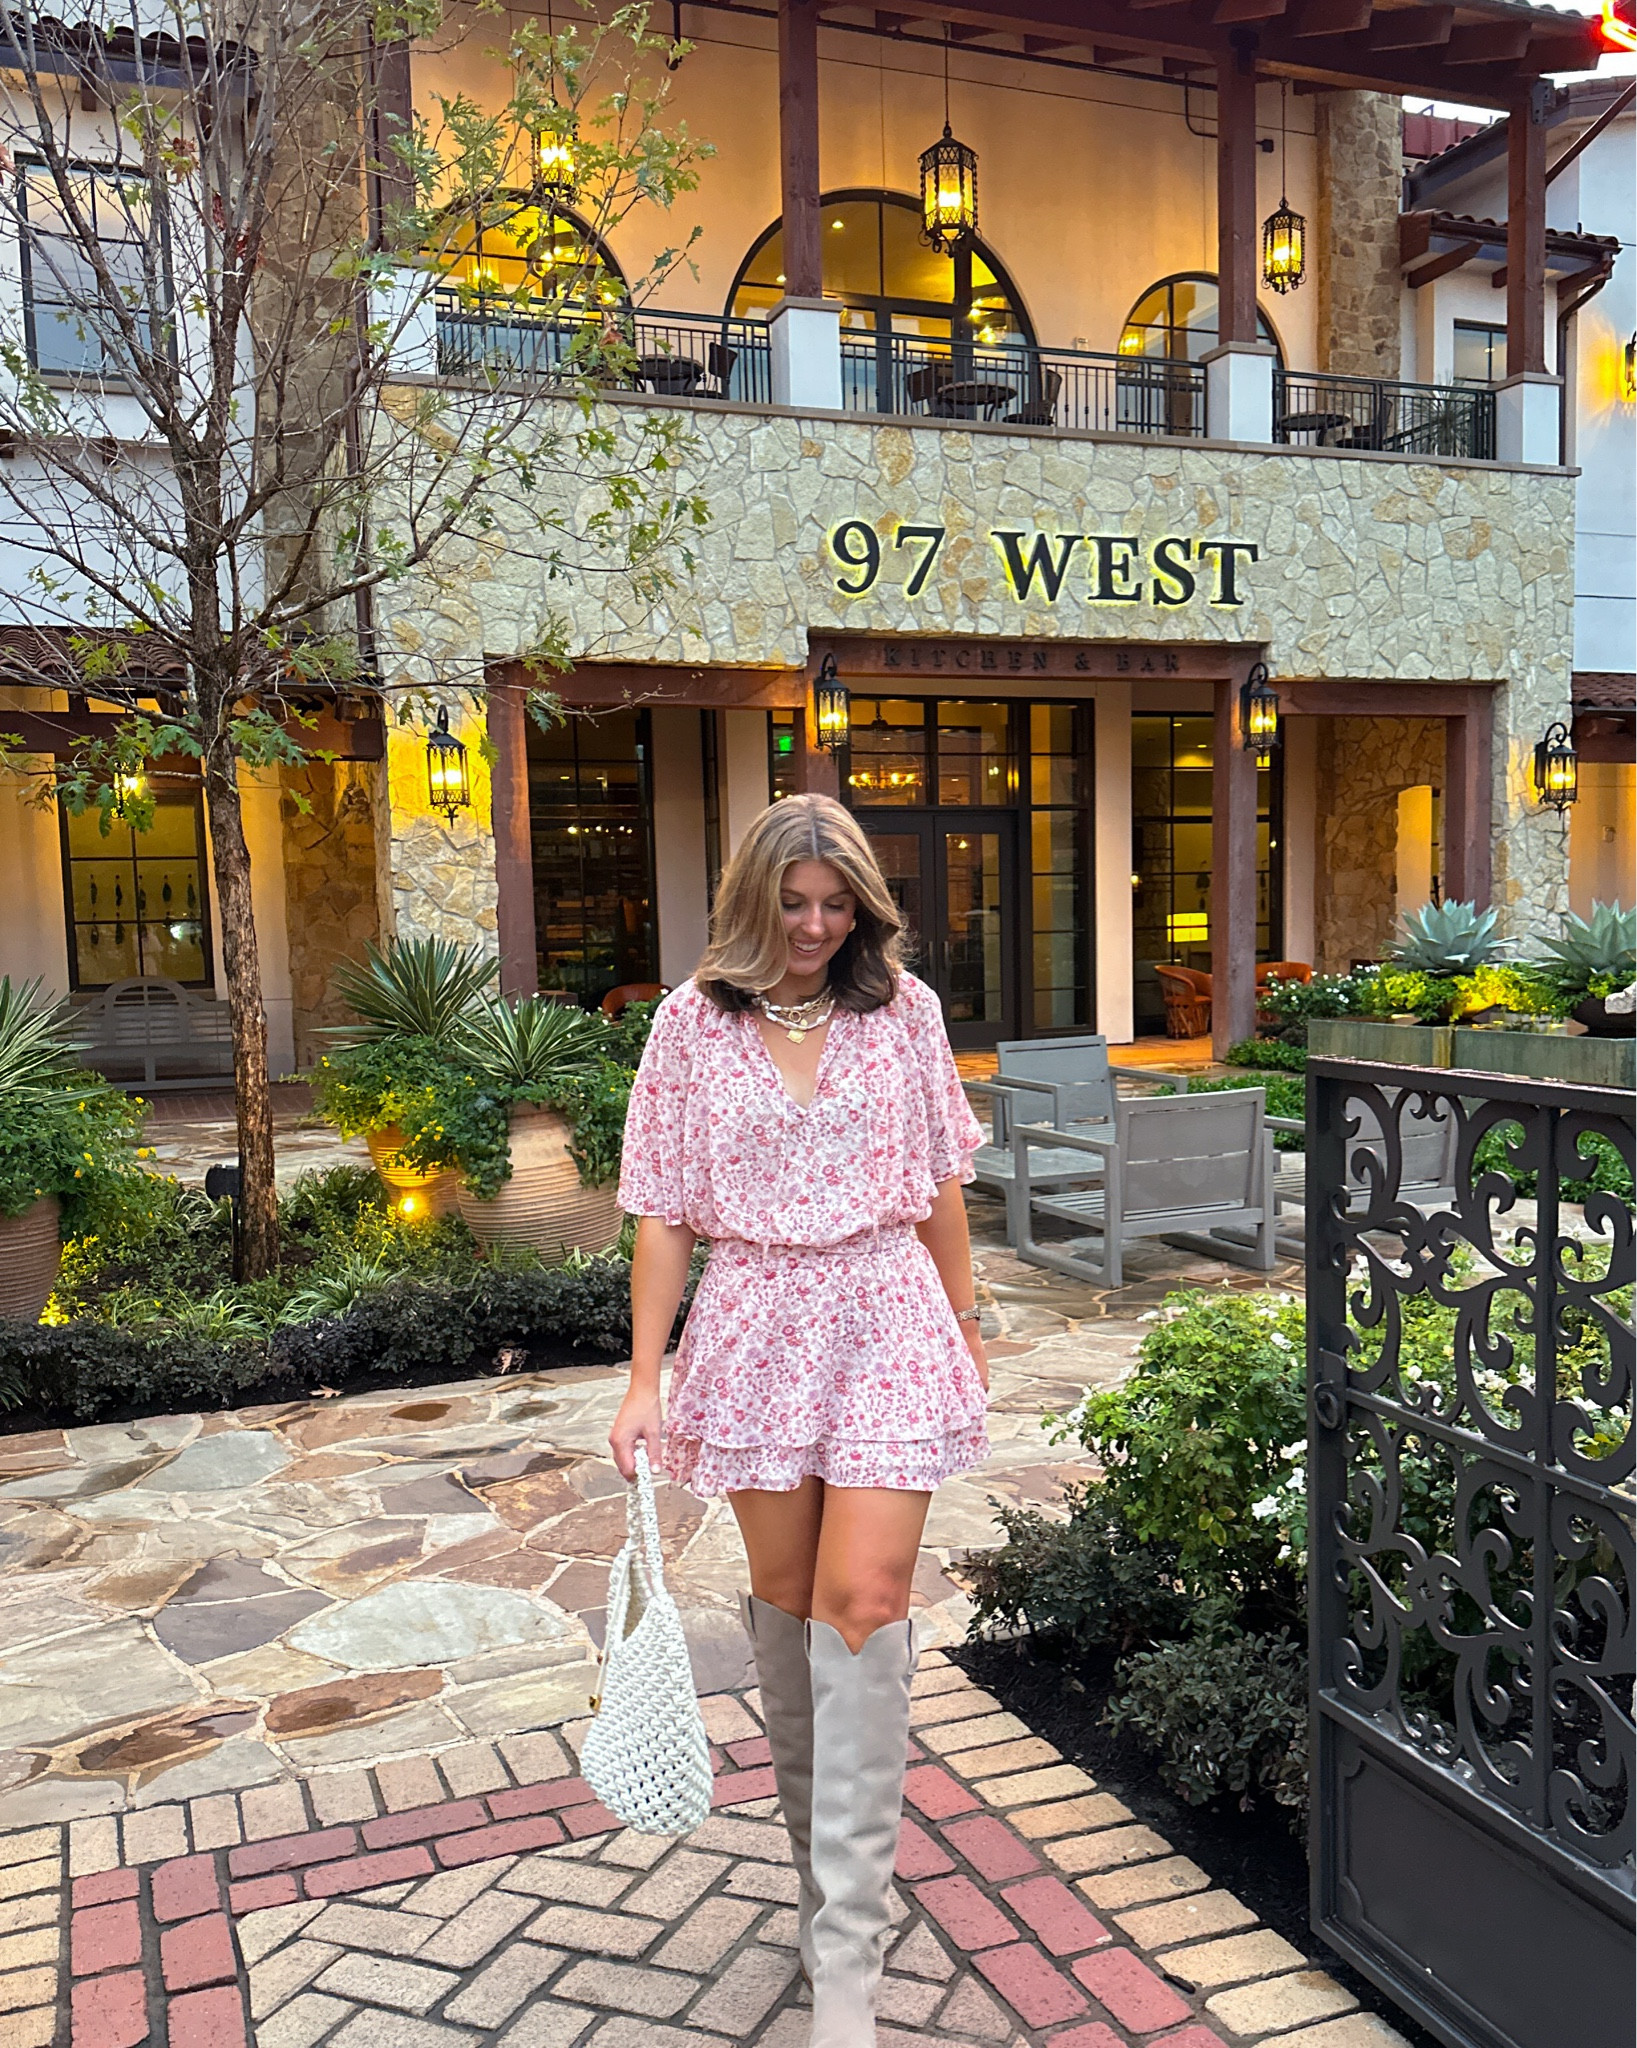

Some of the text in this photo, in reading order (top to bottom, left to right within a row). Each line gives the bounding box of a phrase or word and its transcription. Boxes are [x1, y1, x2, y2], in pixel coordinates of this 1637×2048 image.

[832, 520, 1259, 606] 97 WEST
[883, 645, 1181, 673] KITCHEN & BAR
